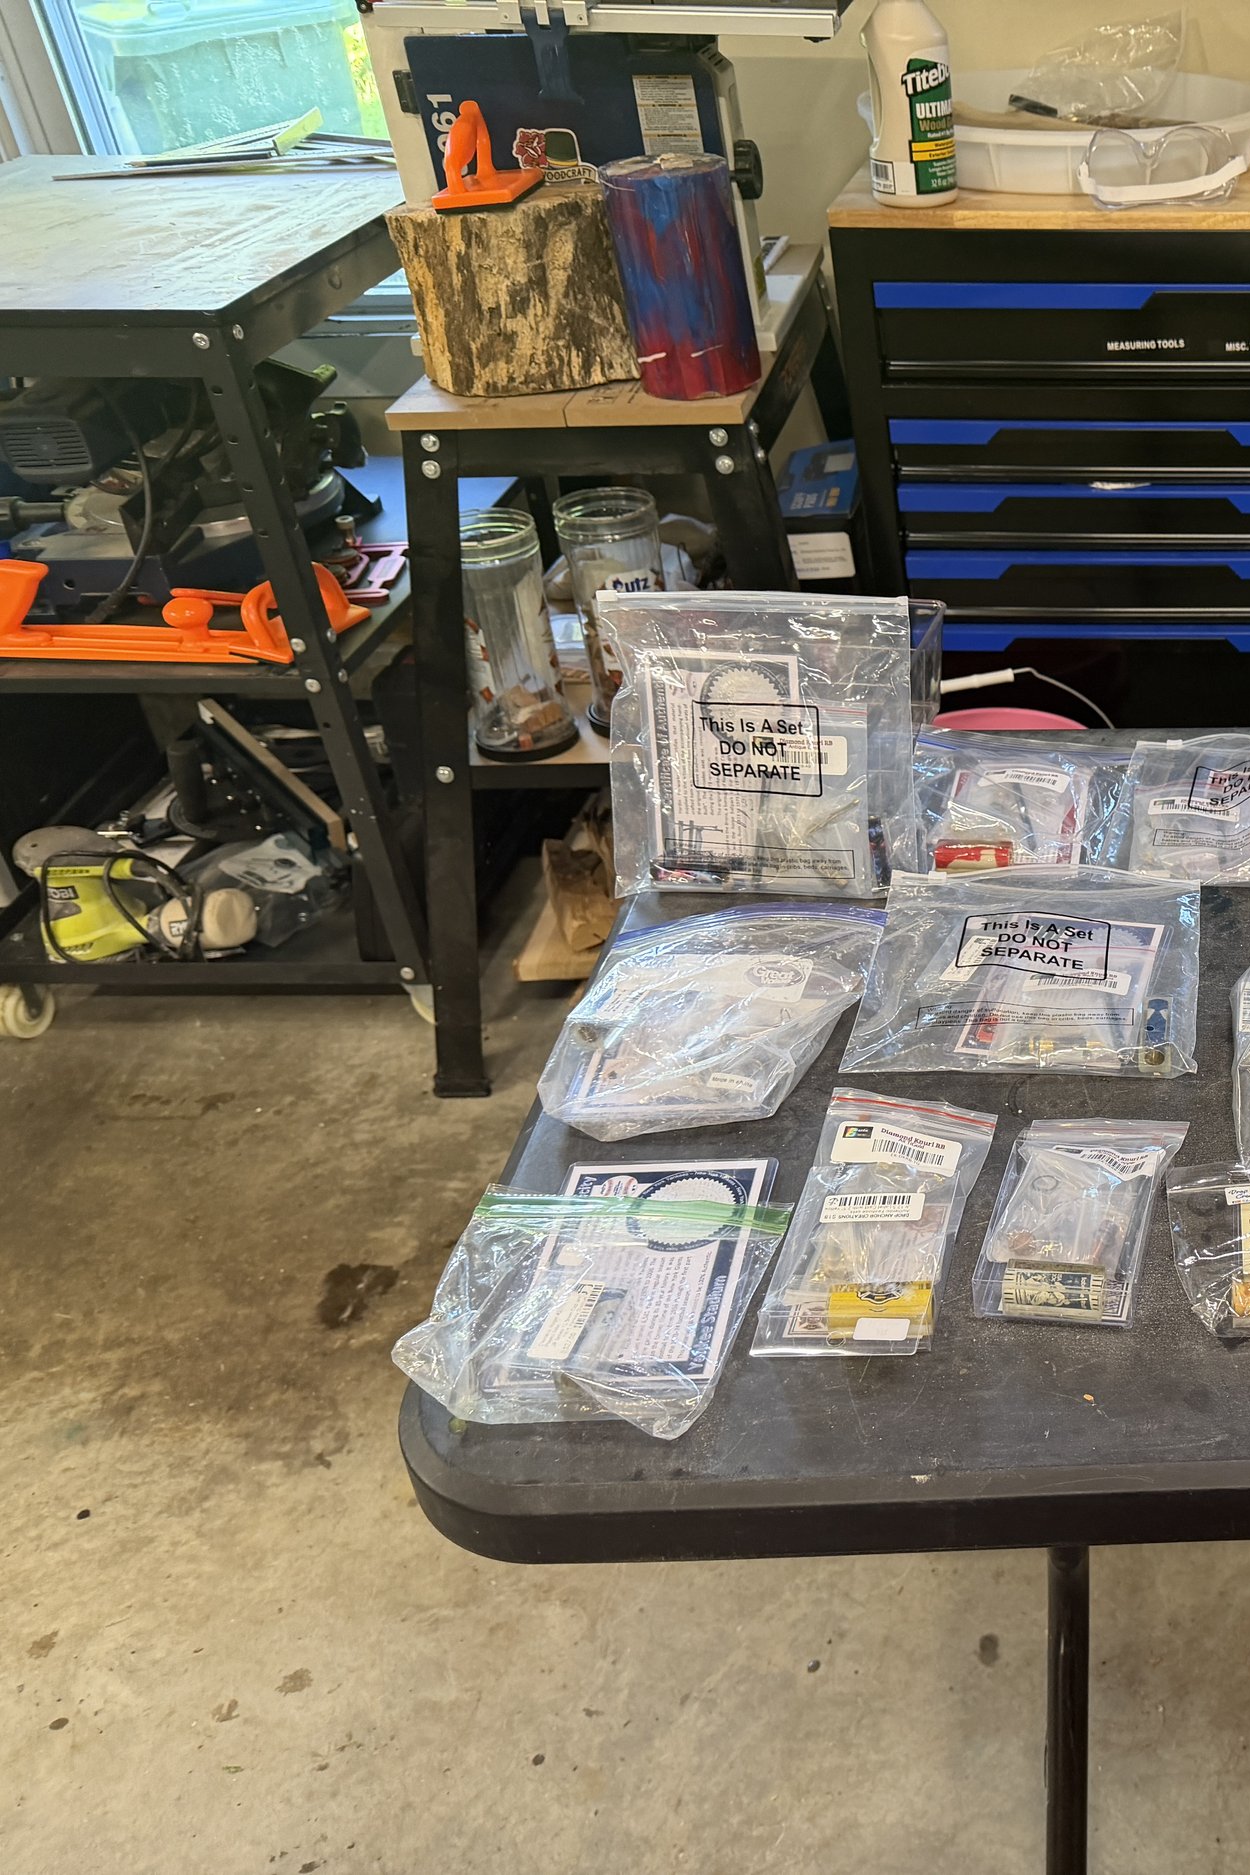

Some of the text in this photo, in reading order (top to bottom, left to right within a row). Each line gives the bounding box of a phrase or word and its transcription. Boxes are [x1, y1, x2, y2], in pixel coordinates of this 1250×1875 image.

[542, 168, 593, 182] OODCRAFT
[1106, 339, 1186, 351] MEASURING TOOLS
[1225, 341, 1249, 351] MISC.
[700, 717, 804, 735] This Is A Set
[719, 740, 787, 757] DO NOT
[659, 748, 672, 804] Certificate
[709, 762, 801, 781] SEPARATE
[1210, 773, 1240, 785] This
[1223, 778, 1244, 794] DO
[981, 919, 1094, 941] This Is A Set
[997, 933, 1073, 953] DO NOT
[981, 947, 1085, 971] SEPARATE
[752, 965, 796, 980] Great
[881, 1127, 914, 1142] Diamond
[913, 1137, 935, 1148] Knurl
[701, 1275, 727, 1325] Stadium
